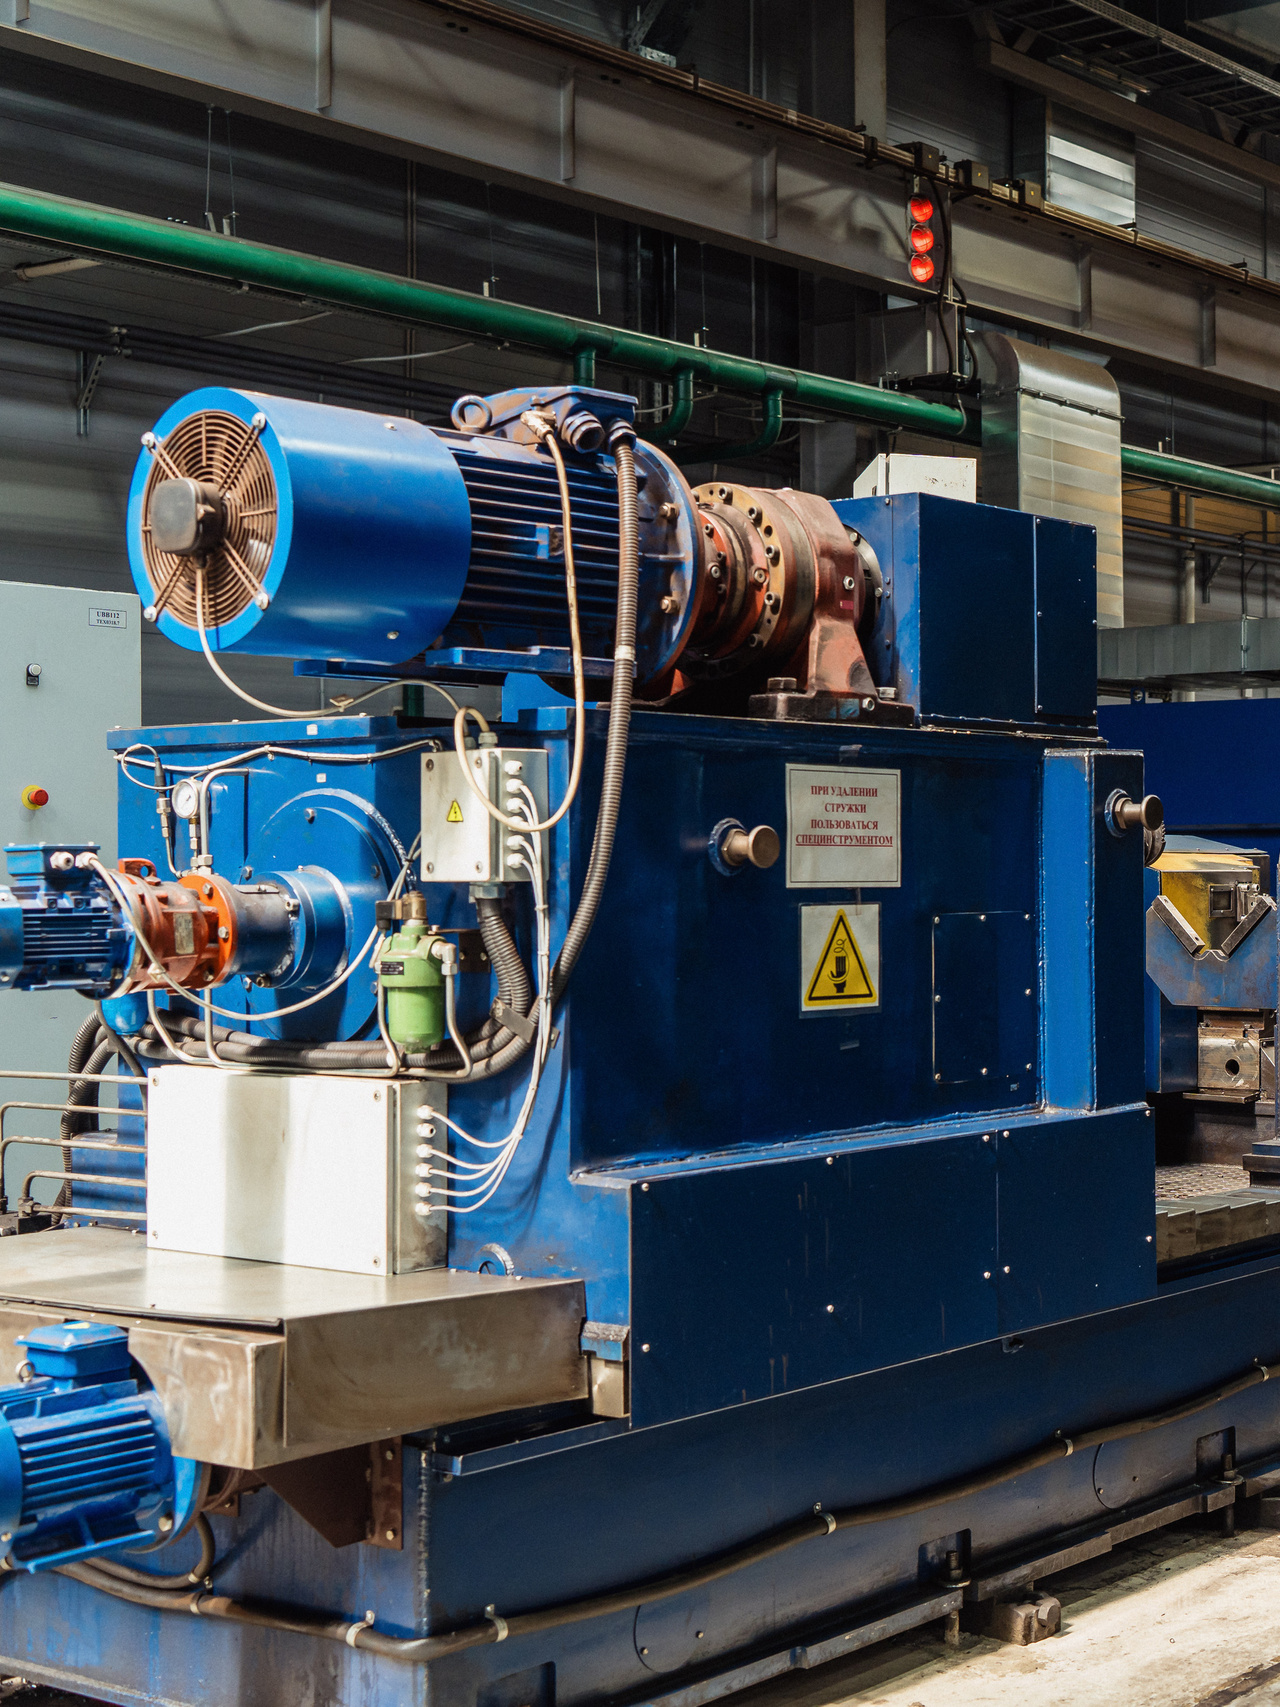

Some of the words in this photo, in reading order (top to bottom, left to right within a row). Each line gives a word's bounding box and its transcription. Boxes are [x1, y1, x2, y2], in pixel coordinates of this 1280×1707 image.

[811, 785, 829, 796] ПРИ
[831, 786, 878, 797] УДАЛЕНИИ
[824, 803, 867, 813] СТРУЖКИ
[810, 819, 879, 830] ПОЛЬЗОВАТЬСЯ
[795, 834, 893, 846] СПЕЦИНСТРУМЕНТОМ
